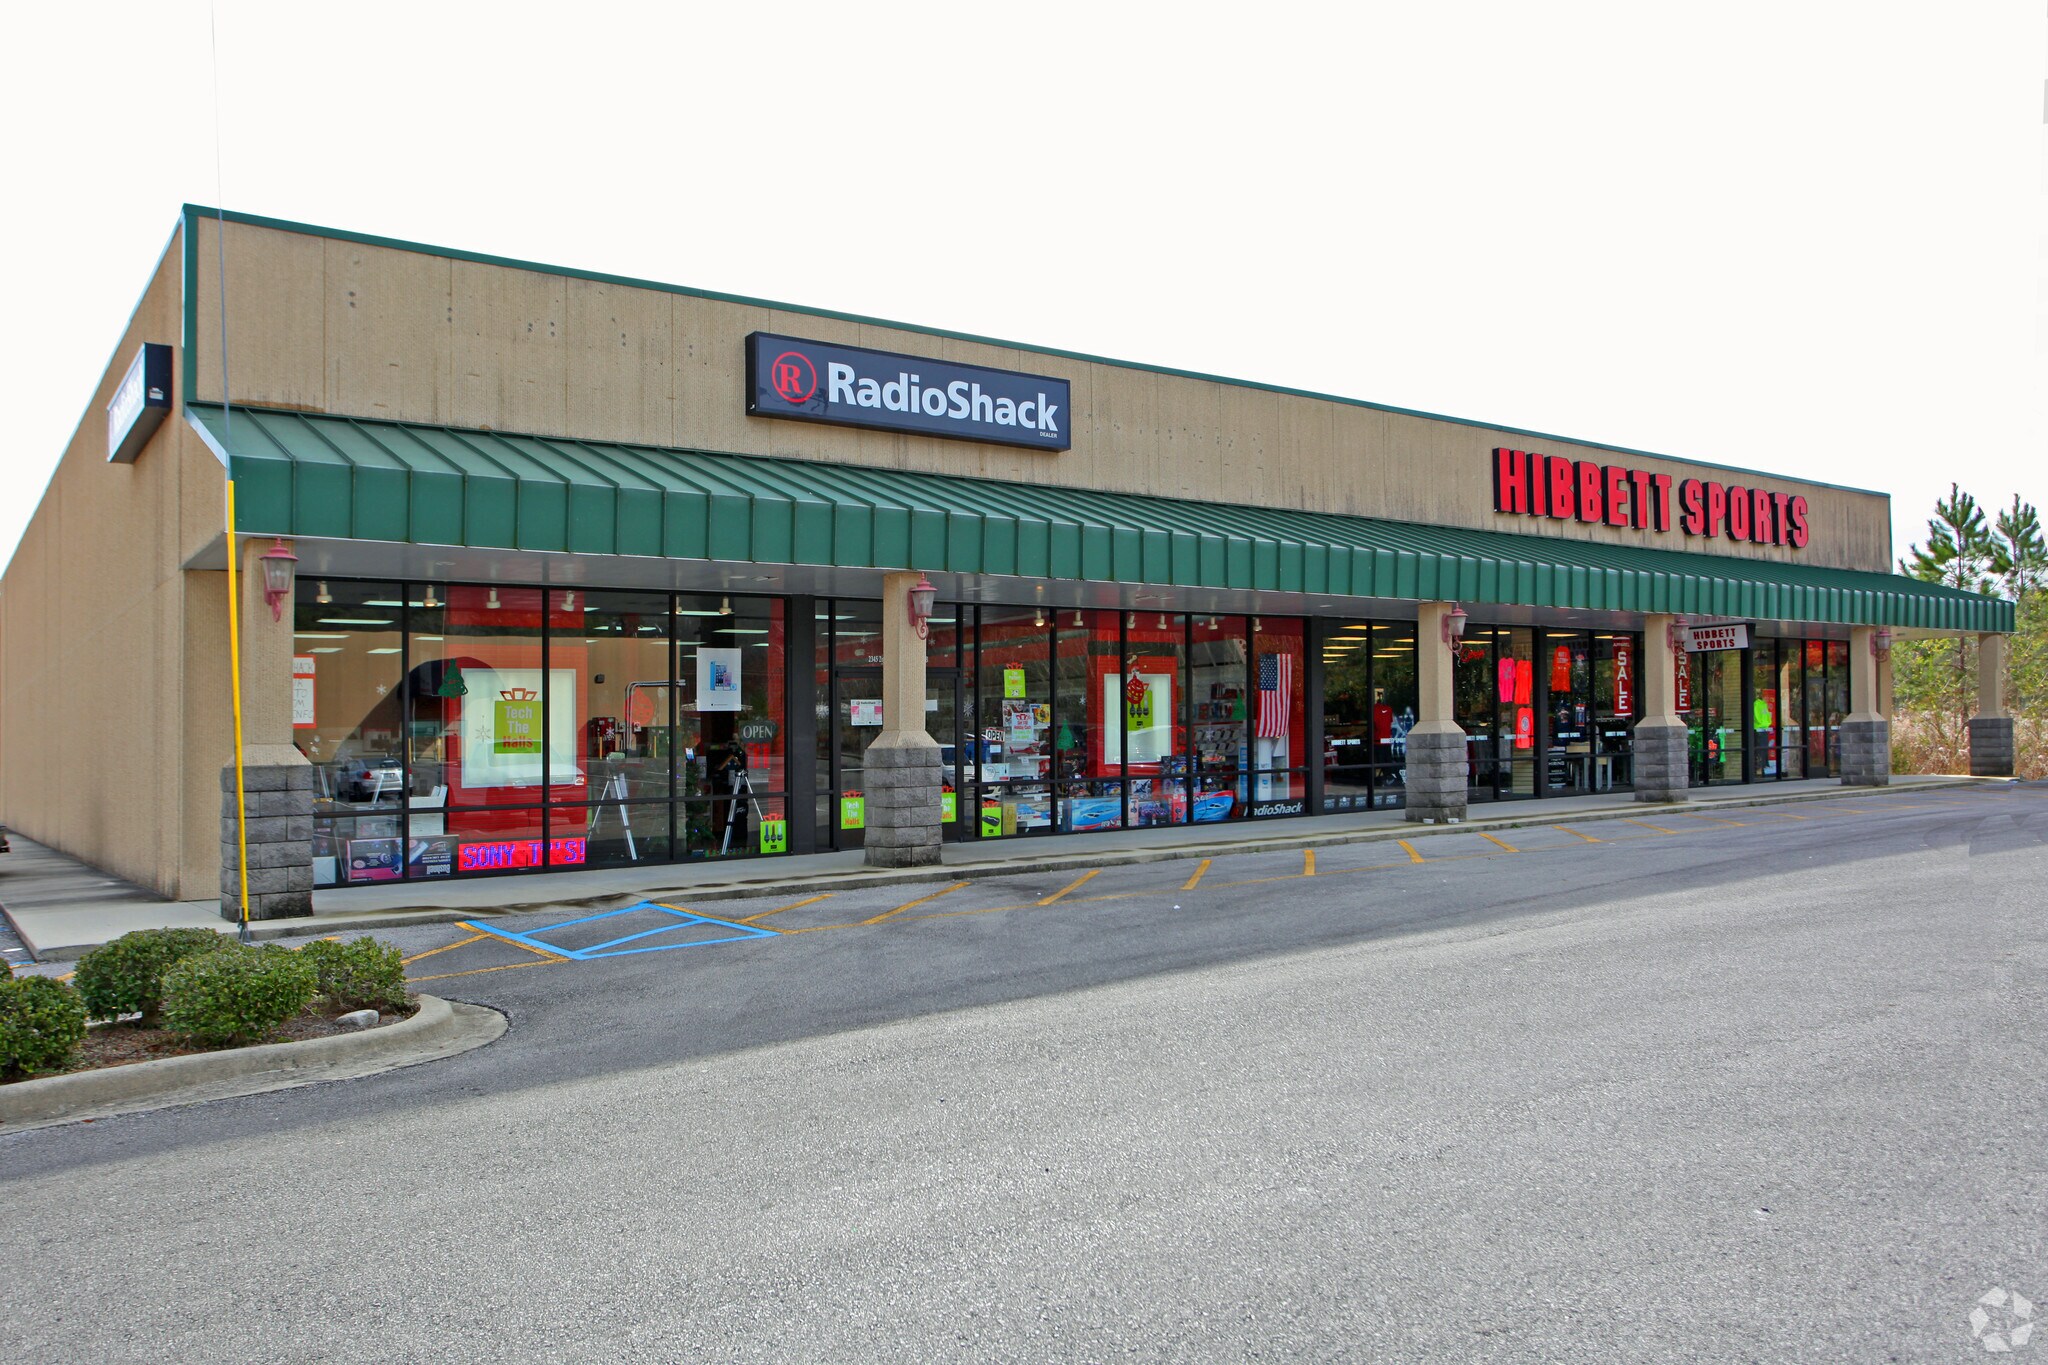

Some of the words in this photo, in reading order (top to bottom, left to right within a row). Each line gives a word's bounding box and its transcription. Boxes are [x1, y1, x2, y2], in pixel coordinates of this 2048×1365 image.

[828, 362, 1059, 432] RadioShack
[1039, 430, 1058, 439] DEALER
[1492, 447, 1672, 532] HIBBETT
[1679, 478, 1809, 548] SPORTS
[1693, 628, 1736, 640] HIBBETT
[1696, 639, 1735, 650] SPORTS
[1617, 651, 1628, 709] SALE
[1678, 648, 1688, 707] SALE
[504, 705, 533, 719] Tech
[507, 720, 530, 734] The
[743, 725, 773, 738] OPEN
[502, 735, 533, 748] Halls
[986, 729, 1004, 742] OPEN
[846, 801, 860, 809] Tech
[463, 844, 516, 868] SONY
[528, 840, 585, 865] T'S!
